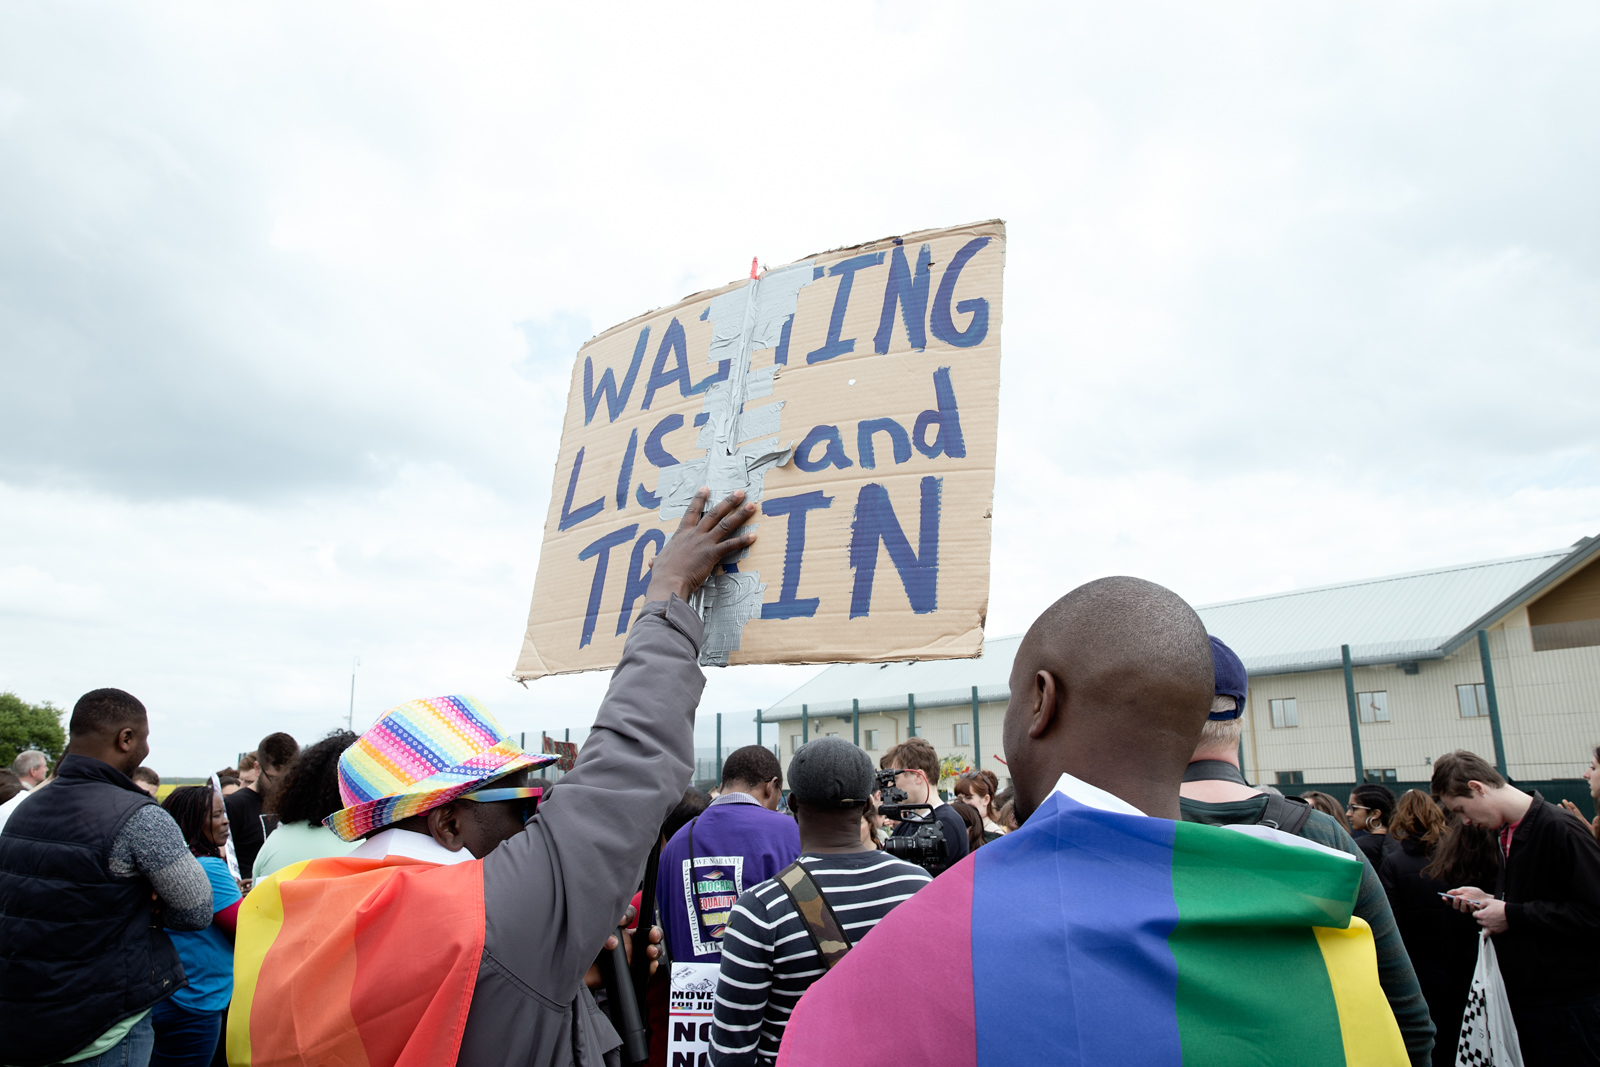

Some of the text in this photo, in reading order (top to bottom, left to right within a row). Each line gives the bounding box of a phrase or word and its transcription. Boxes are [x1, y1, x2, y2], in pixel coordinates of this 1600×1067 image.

[557, 366, 966, 532] LIS and
[578, 477, 943, 650] TRIN
[692, 880, 736, 894] EMOCRA
[699, 895, 737, 911] EQUALITY
[702, 911, 730, 926] FREEDO
[671, 991, 714, 1000] MOVE
[696, 1001, 713, 1010] JU
